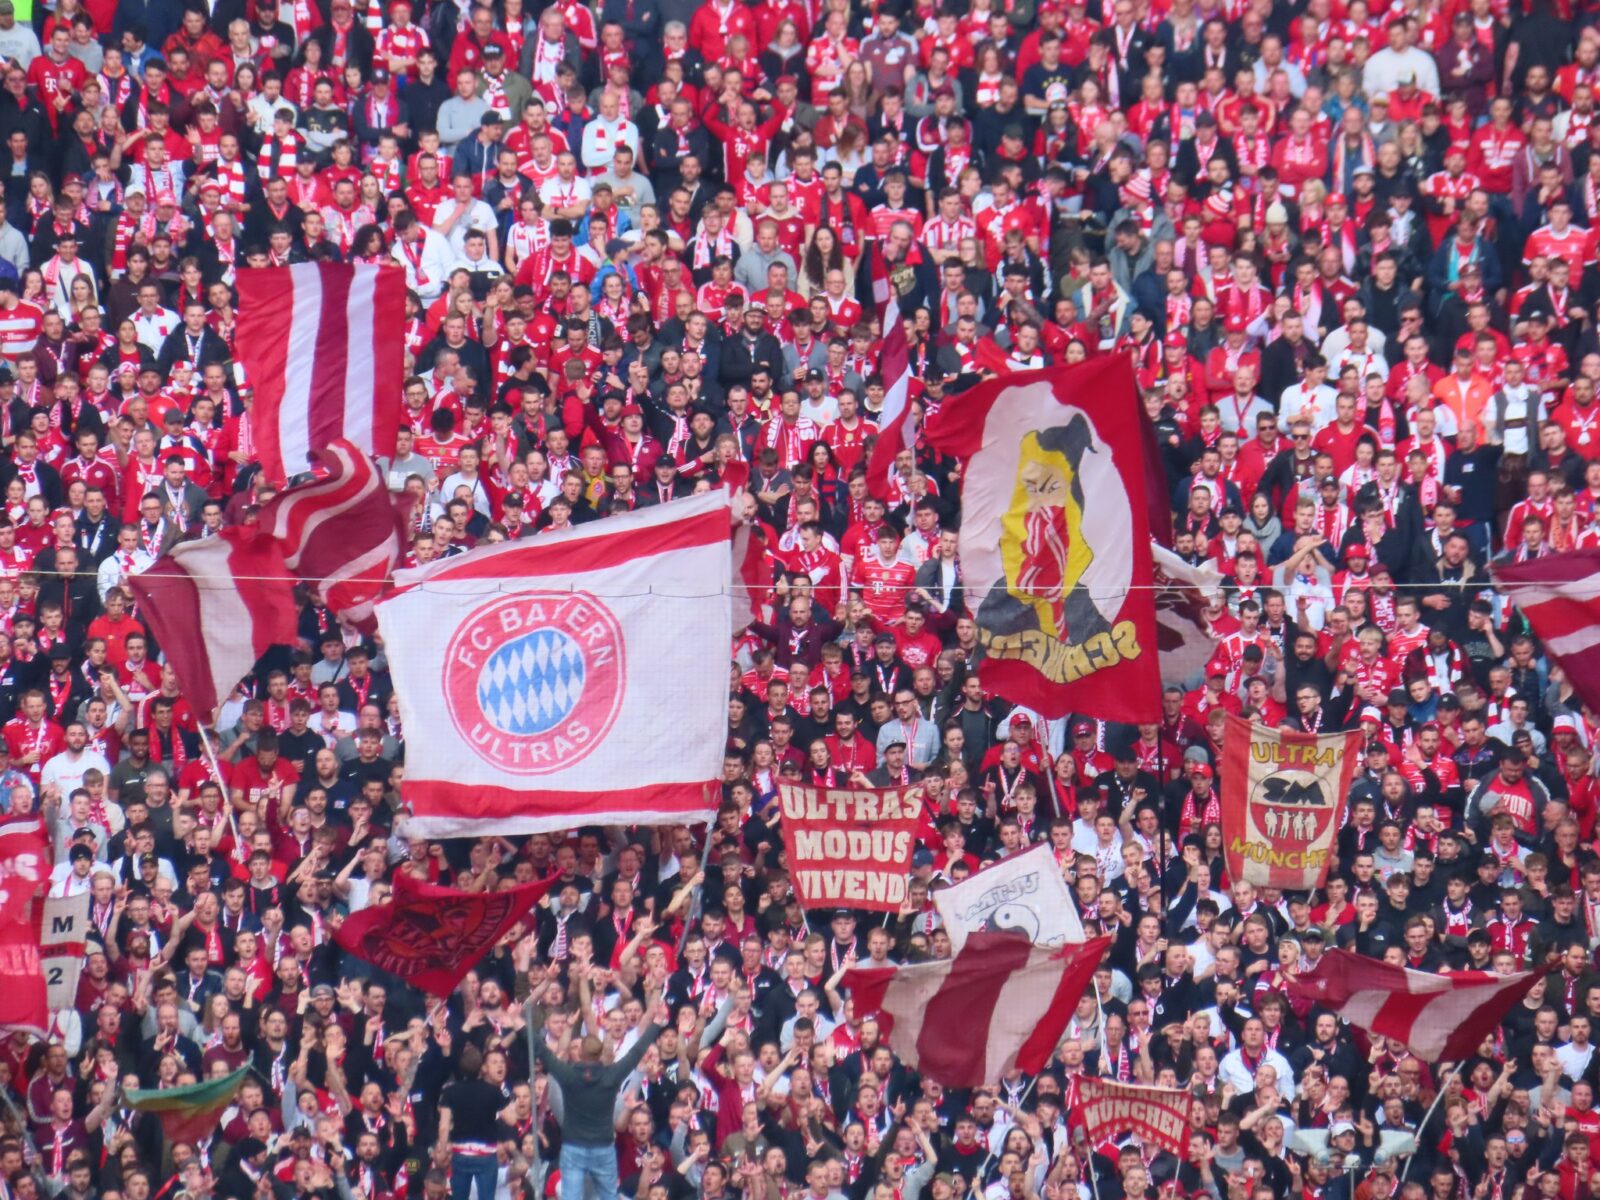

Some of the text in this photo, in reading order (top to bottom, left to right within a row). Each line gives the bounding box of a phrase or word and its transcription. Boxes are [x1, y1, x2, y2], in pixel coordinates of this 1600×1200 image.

[458, 599, 613, 669] FC BAYERN
[470, 720, 590, 763] ULTRAS
[779, 784, 924, 821] ULTRAS
[794, 829, 911, 864] MODUS
[52, 915, 74, 934] M
[48, 967, 63, 986] 2
[1084, 1098, 1185, 1143] MÜNCHEN
